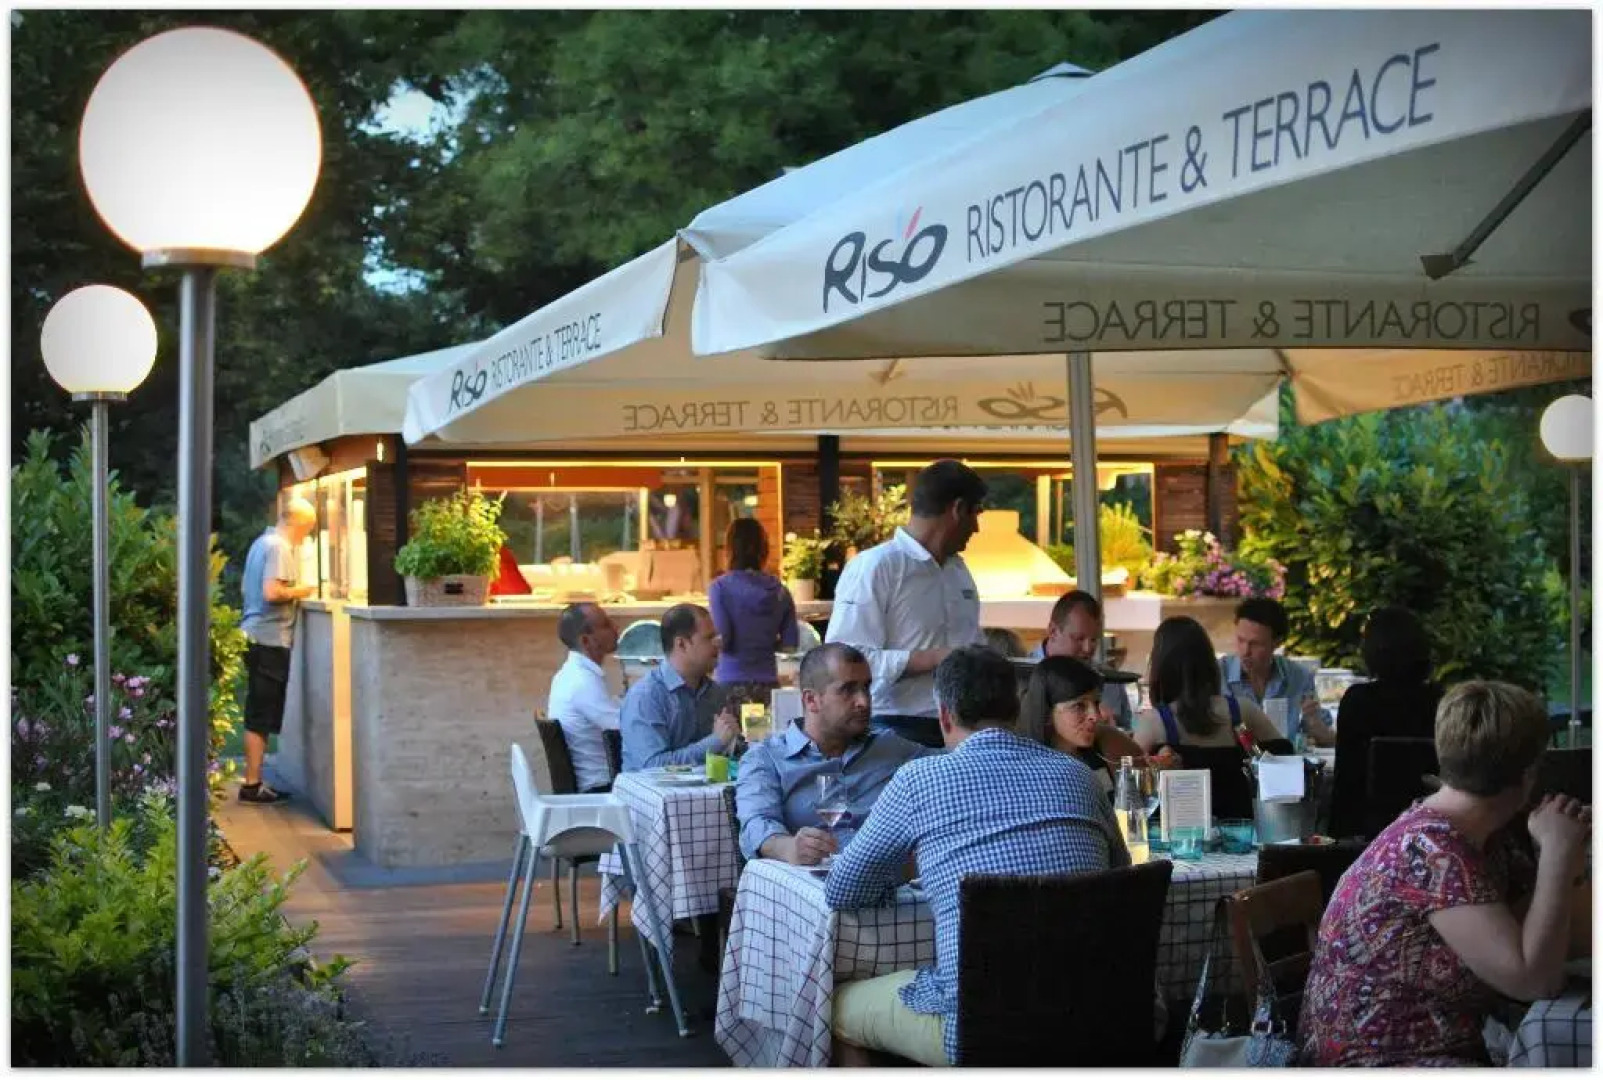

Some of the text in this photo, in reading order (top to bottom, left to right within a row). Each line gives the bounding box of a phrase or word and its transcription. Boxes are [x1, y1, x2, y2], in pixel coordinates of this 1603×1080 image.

[966, 134, 1170, 264] RISTORANTE
[1180, 124, 1208, 194] &
[1222, 42, 1441, 178] TERRACE
[554, 312, 602, 361] TERRACE
